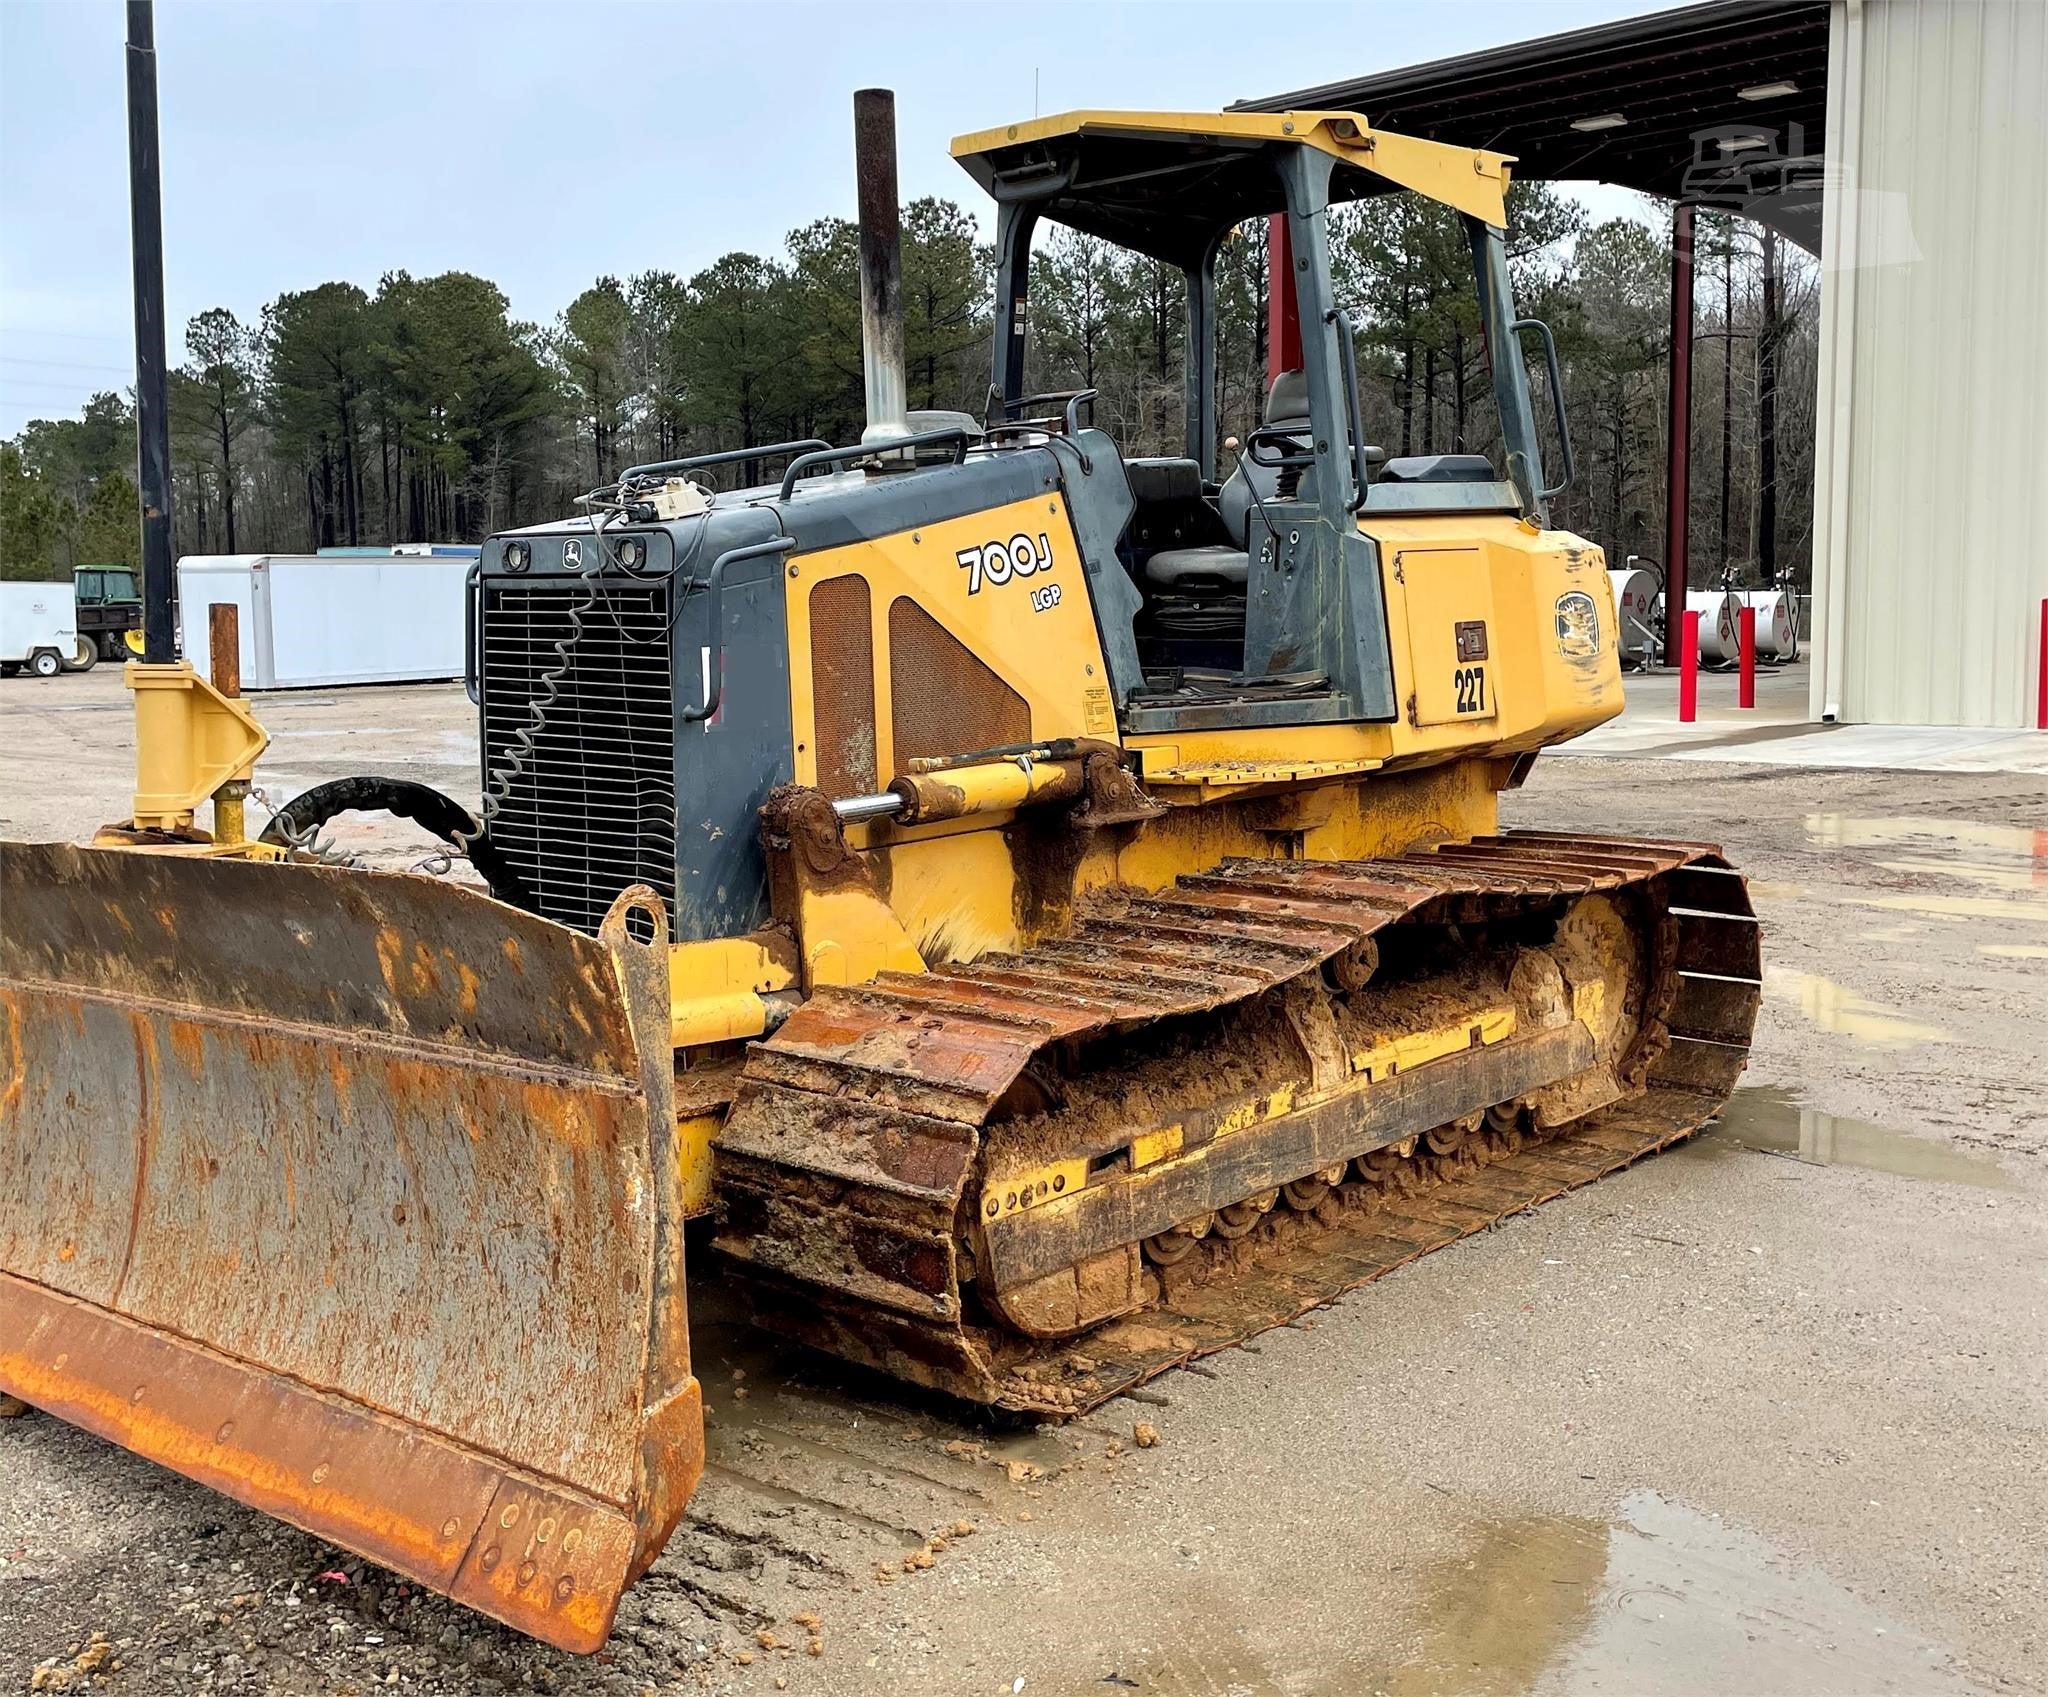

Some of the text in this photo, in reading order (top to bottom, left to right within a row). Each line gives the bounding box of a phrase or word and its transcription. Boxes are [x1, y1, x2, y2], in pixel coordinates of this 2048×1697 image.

[956, 533, 1053, 596] 700J
[1031, 584, 1062, 613] LGP
[1455, 667, 1484, 713] 227
